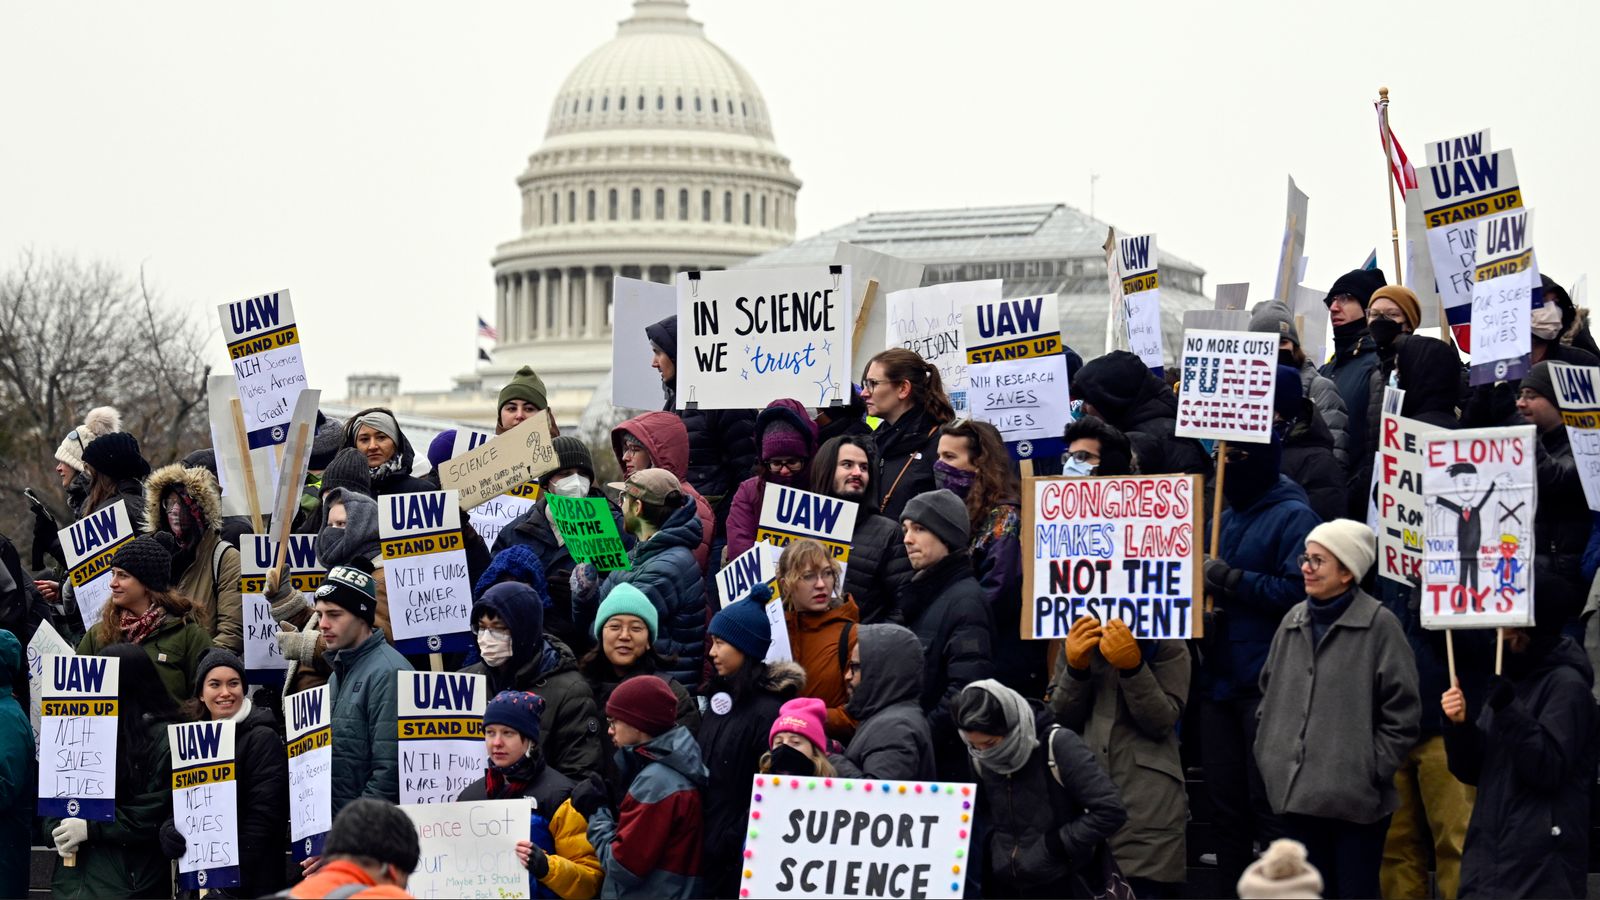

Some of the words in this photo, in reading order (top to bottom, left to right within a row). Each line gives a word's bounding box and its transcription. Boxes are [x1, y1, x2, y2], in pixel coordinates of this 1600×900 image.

[1430, 152, 1499, 200] UAW
[1430, 201, 1489, 229] STAND
[1494, 194, 1518, 211] UP
[1487, 211, 1528, 255] UAW
[1121, 235, 1150, 270] UAW
[1124, 279, 1143, 295] STAND
[1146, 276, 1156, 289] UP
[1477, 261, 1517, 282] STAND
[229, 292, 279, 335] UAW
[693, 299, 719, 336] IN
[734, 289, 835, 336] SCIENCE
[976, 297, 1043, 338] UAW
[232, 338, 273, 359] STAND
[276, 331, 295, 346] UP
[694, 342, 728, 373] WE
[750, 342, 816, 374] trust
[971, 344, 1028, 364] STAND
[1034, 338, 1057, 354] UP
[1186, 337, 1203, 352] NO
[1206, 339, 1240, 355] MORE
[1244, 340, 1274, 356] CUTS!
[234, 357, 262, 381] NIH
[263, 353, 298, 371] Science
[970, 375, 991, 389] NIH
[996, 371, 1055, 387] RESEARCH
[1183, 356, 1272, 400] FUND
[270, 373, 306, 391] America
[1554, 366, 1597, 404] UAW
[256, 397, 289, 423] Great!
[986, 390, 1038, 406] SAVES
[1180, 400, 1269, 432] SCIENCE!
[449, 446, 498, 483] SCIENCE
[1428, 437, 1524, 468] ELON'S
[493, 468, 510, 481] CURED
[511, 461, 525, 474] YOUR
[480, 483, 503, 499] BRAIN
[510, 484, 534, 497] UP
[1041, 478, 1189, 521] CONGRESS
[391, 492, 447, 531] UAW
[776, 488, 843, 535] UAW
[69, 506, 118, 557] UAW
[577, 520, 604, 536] THE
[1036, 522, 1115, 559] MAKES
[1124, 522, 1192, 558] LAWS
[385, 538, 435, 557] STAND
[439, 535, 459, 549] UP
[1426, 539, 1454, 552] YOUR
[589, 553, 626, 569] HERE
[723, 546, 762, 602] UAW
[1428, 559, 1456, 575] DATA
[246, 576, 303, 592] STD
[394, 567, 424, 589] NIH
[433, 563, 466, 581] FUNDS
[1049, 559, 1112, 595] NOT
[1122, 559, 1182, 596] THE
[408, 586, 457, 608] CANCER
[1426, 584, 1516, 615] TOYS
[405, 604, 468, 627] RESEARCH
[54, 655, 107, 693] UAW
[413, 673, 476, 711] UAW
[45, 702, 89, 716] STAND
[94, 702, 114, 716] UP
[292, 688, 323, 732] UAW
[55, 716, 95, 747] NIH
[176, 722, 223, 761] UAW
[403, 721, 462, 736] STAND
[290, 738, 314, 759] STAND
[316, 731, 329, 747] UP
[56, 749, 103, 771] SAVES
[403, 750, 441, 774] NIH
[449, 754, 481, 771] FUNDS
[54, 775, 105, 799] LIVES
[175, 769, 208, 788] STAND
[212, 766, 231, 781] UP
[405, 777, 439, 792] RARE
[186, 787, 213, 810] NIH
[185, 814, 223, 836] SAVES
[469, 805, 515, 837] Got
[781, 808, 939, 848] SUPPORT
[187, 841, 231, 866] LIVES
[775, 857, 931, 899] SCIENCE
